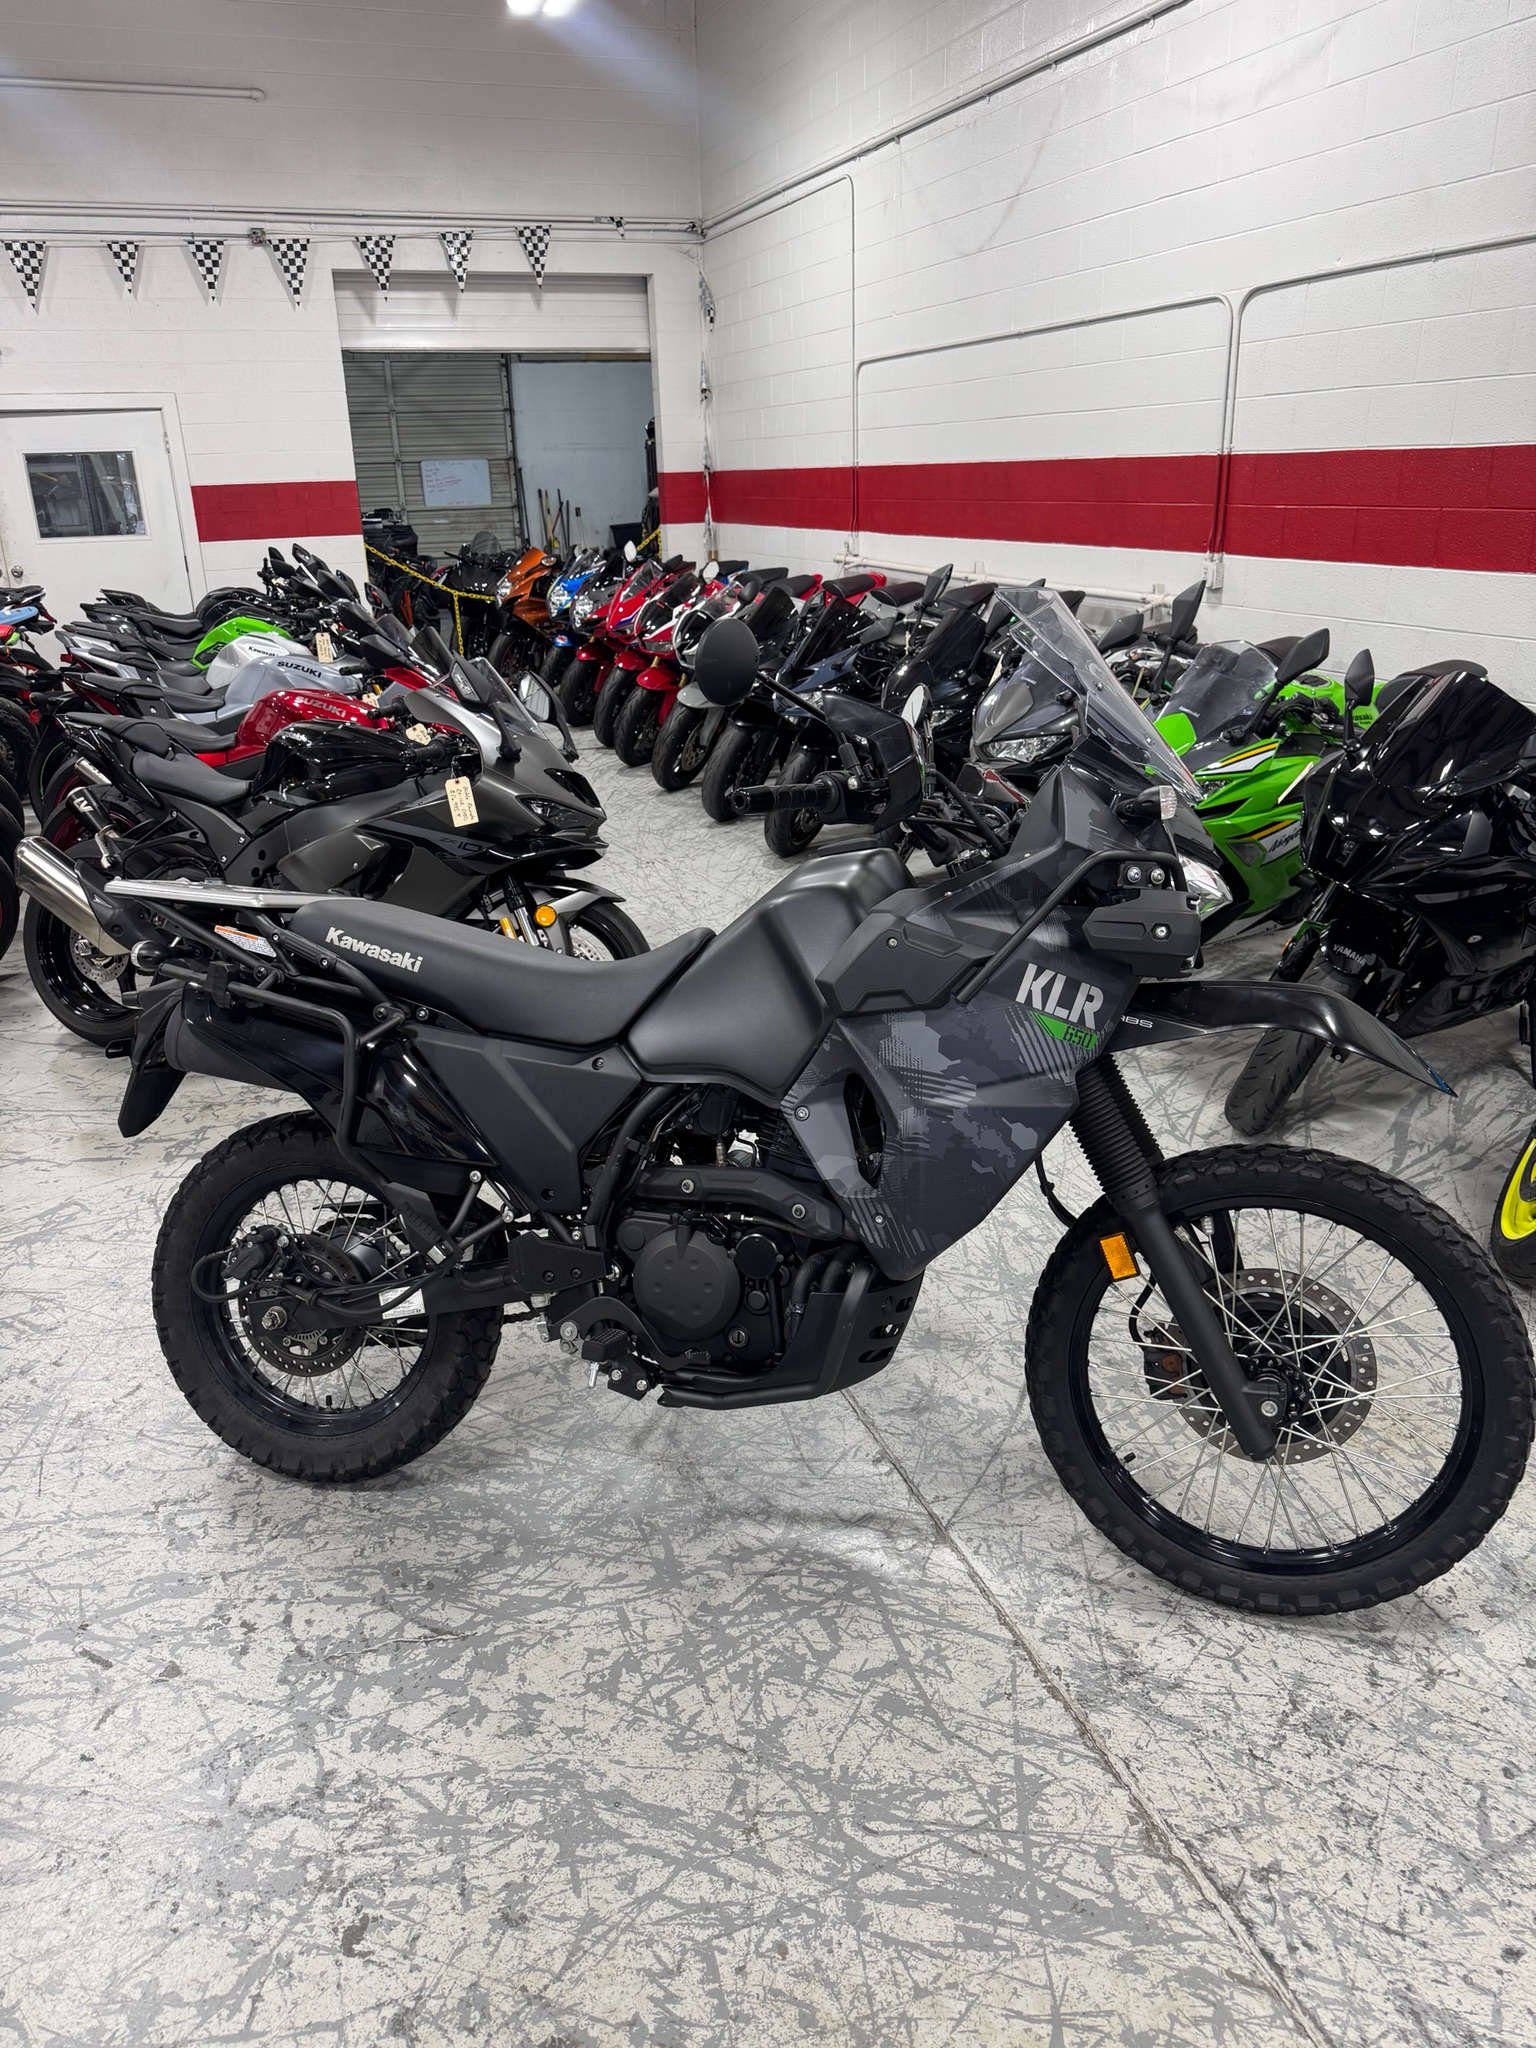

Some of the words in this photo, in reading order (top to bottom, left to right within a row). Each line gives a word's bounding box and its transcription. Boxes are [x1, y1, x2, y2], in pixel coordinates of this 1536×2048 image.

[277, 661, 322, 678] SUZUKI
[294, 696, 347, 718] SUZUKI
[73, 796, 94, 813] LV
[325, 926, 423, 973] Kawasaki
[1333, 944, 1366, 967] YAMAHA
[1015, 962, 1104, 1030] KLR
[1062, 1025, 1095, 1049] 650
